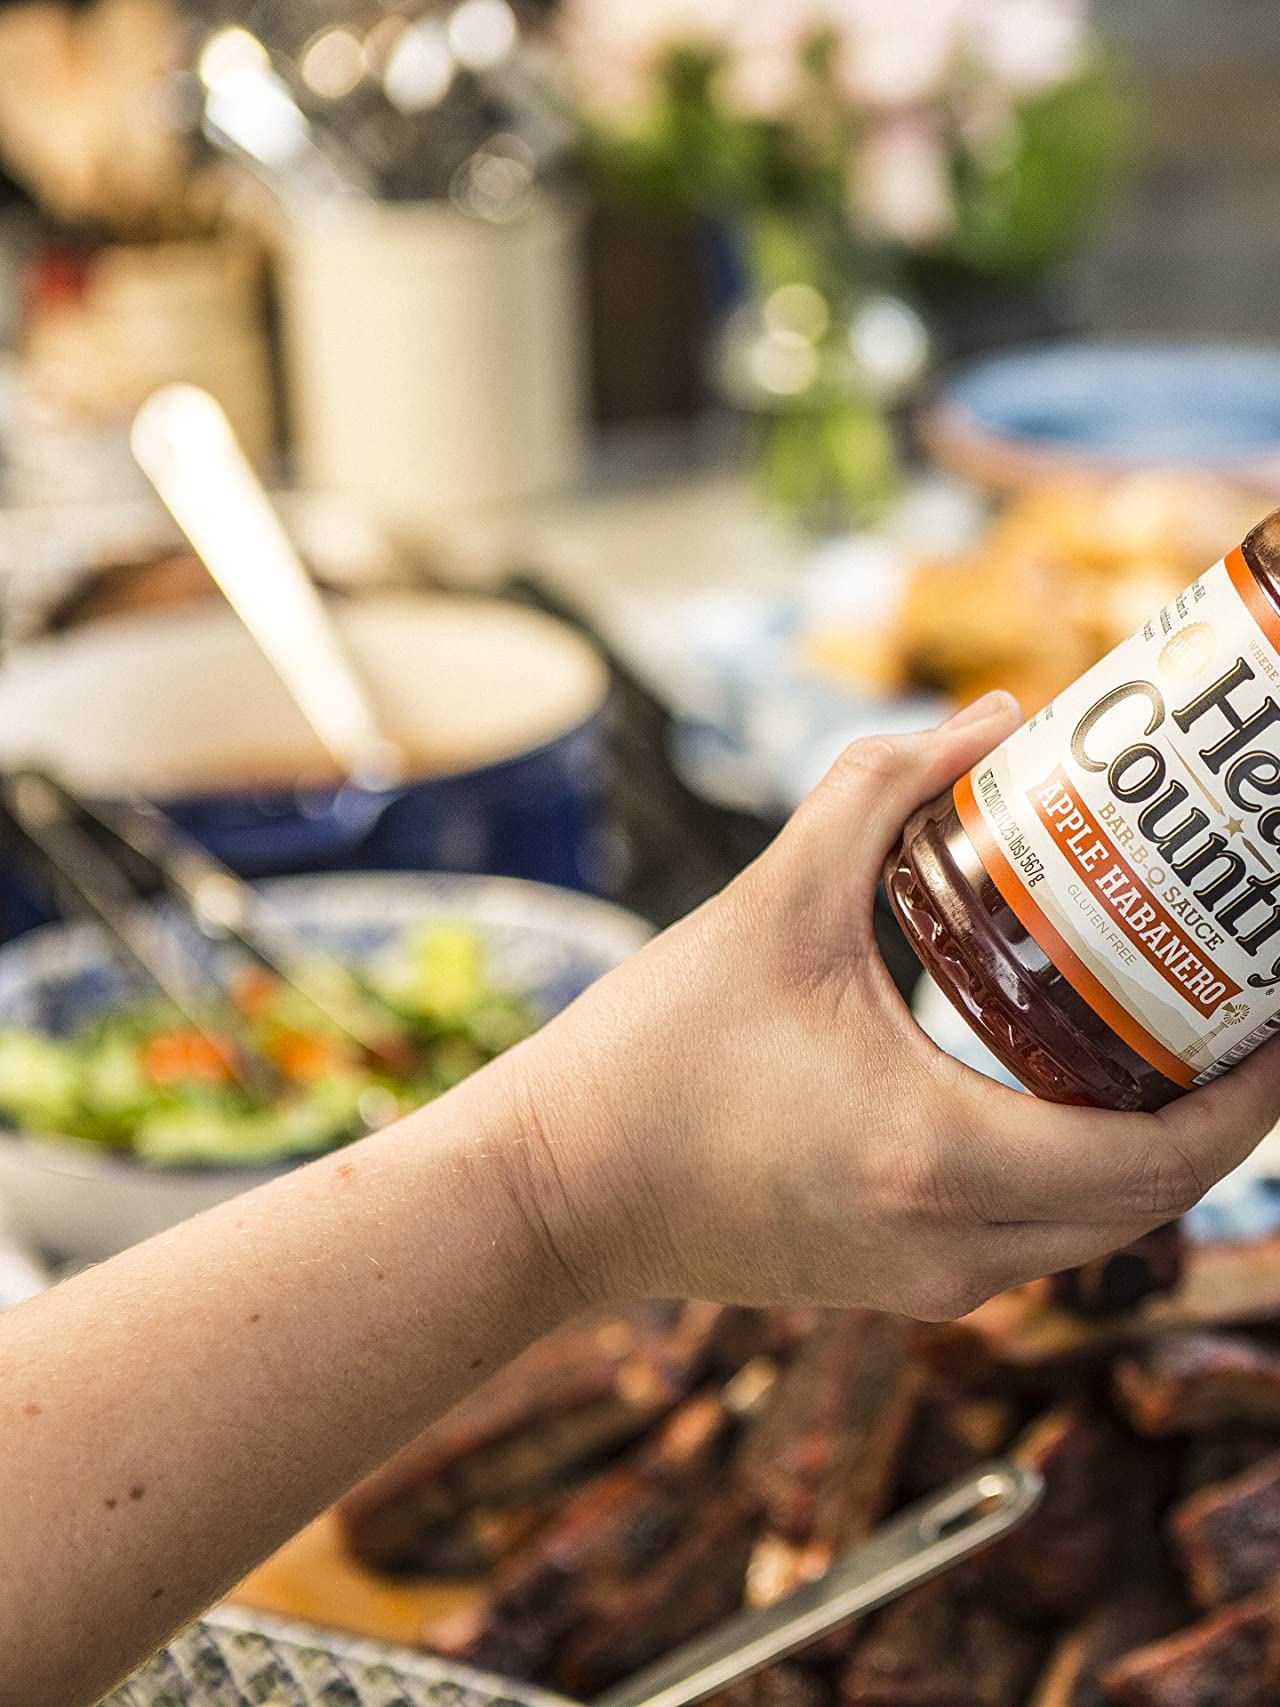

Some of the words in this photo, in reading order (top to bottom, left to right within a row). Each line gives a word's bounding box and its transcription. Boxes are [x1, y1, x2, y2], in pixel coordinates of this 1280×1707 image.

[1248, 639, 1280, 681] WHERE
[1008, 834, 1030, 860] lbs)
[1020, 852, 1045, 888] 567g
[1035, 780, 1110, 873] APPLE
[1095, 863, 1227, 1005] HABANERO
[1098, 802, 1166, 889] BAR-B-Q
[1162, 886, 1225, 952] SAUCE
[1067, 883, 1110, 936] GLUTEN
[1105, 930, 1138, 967] FREE
